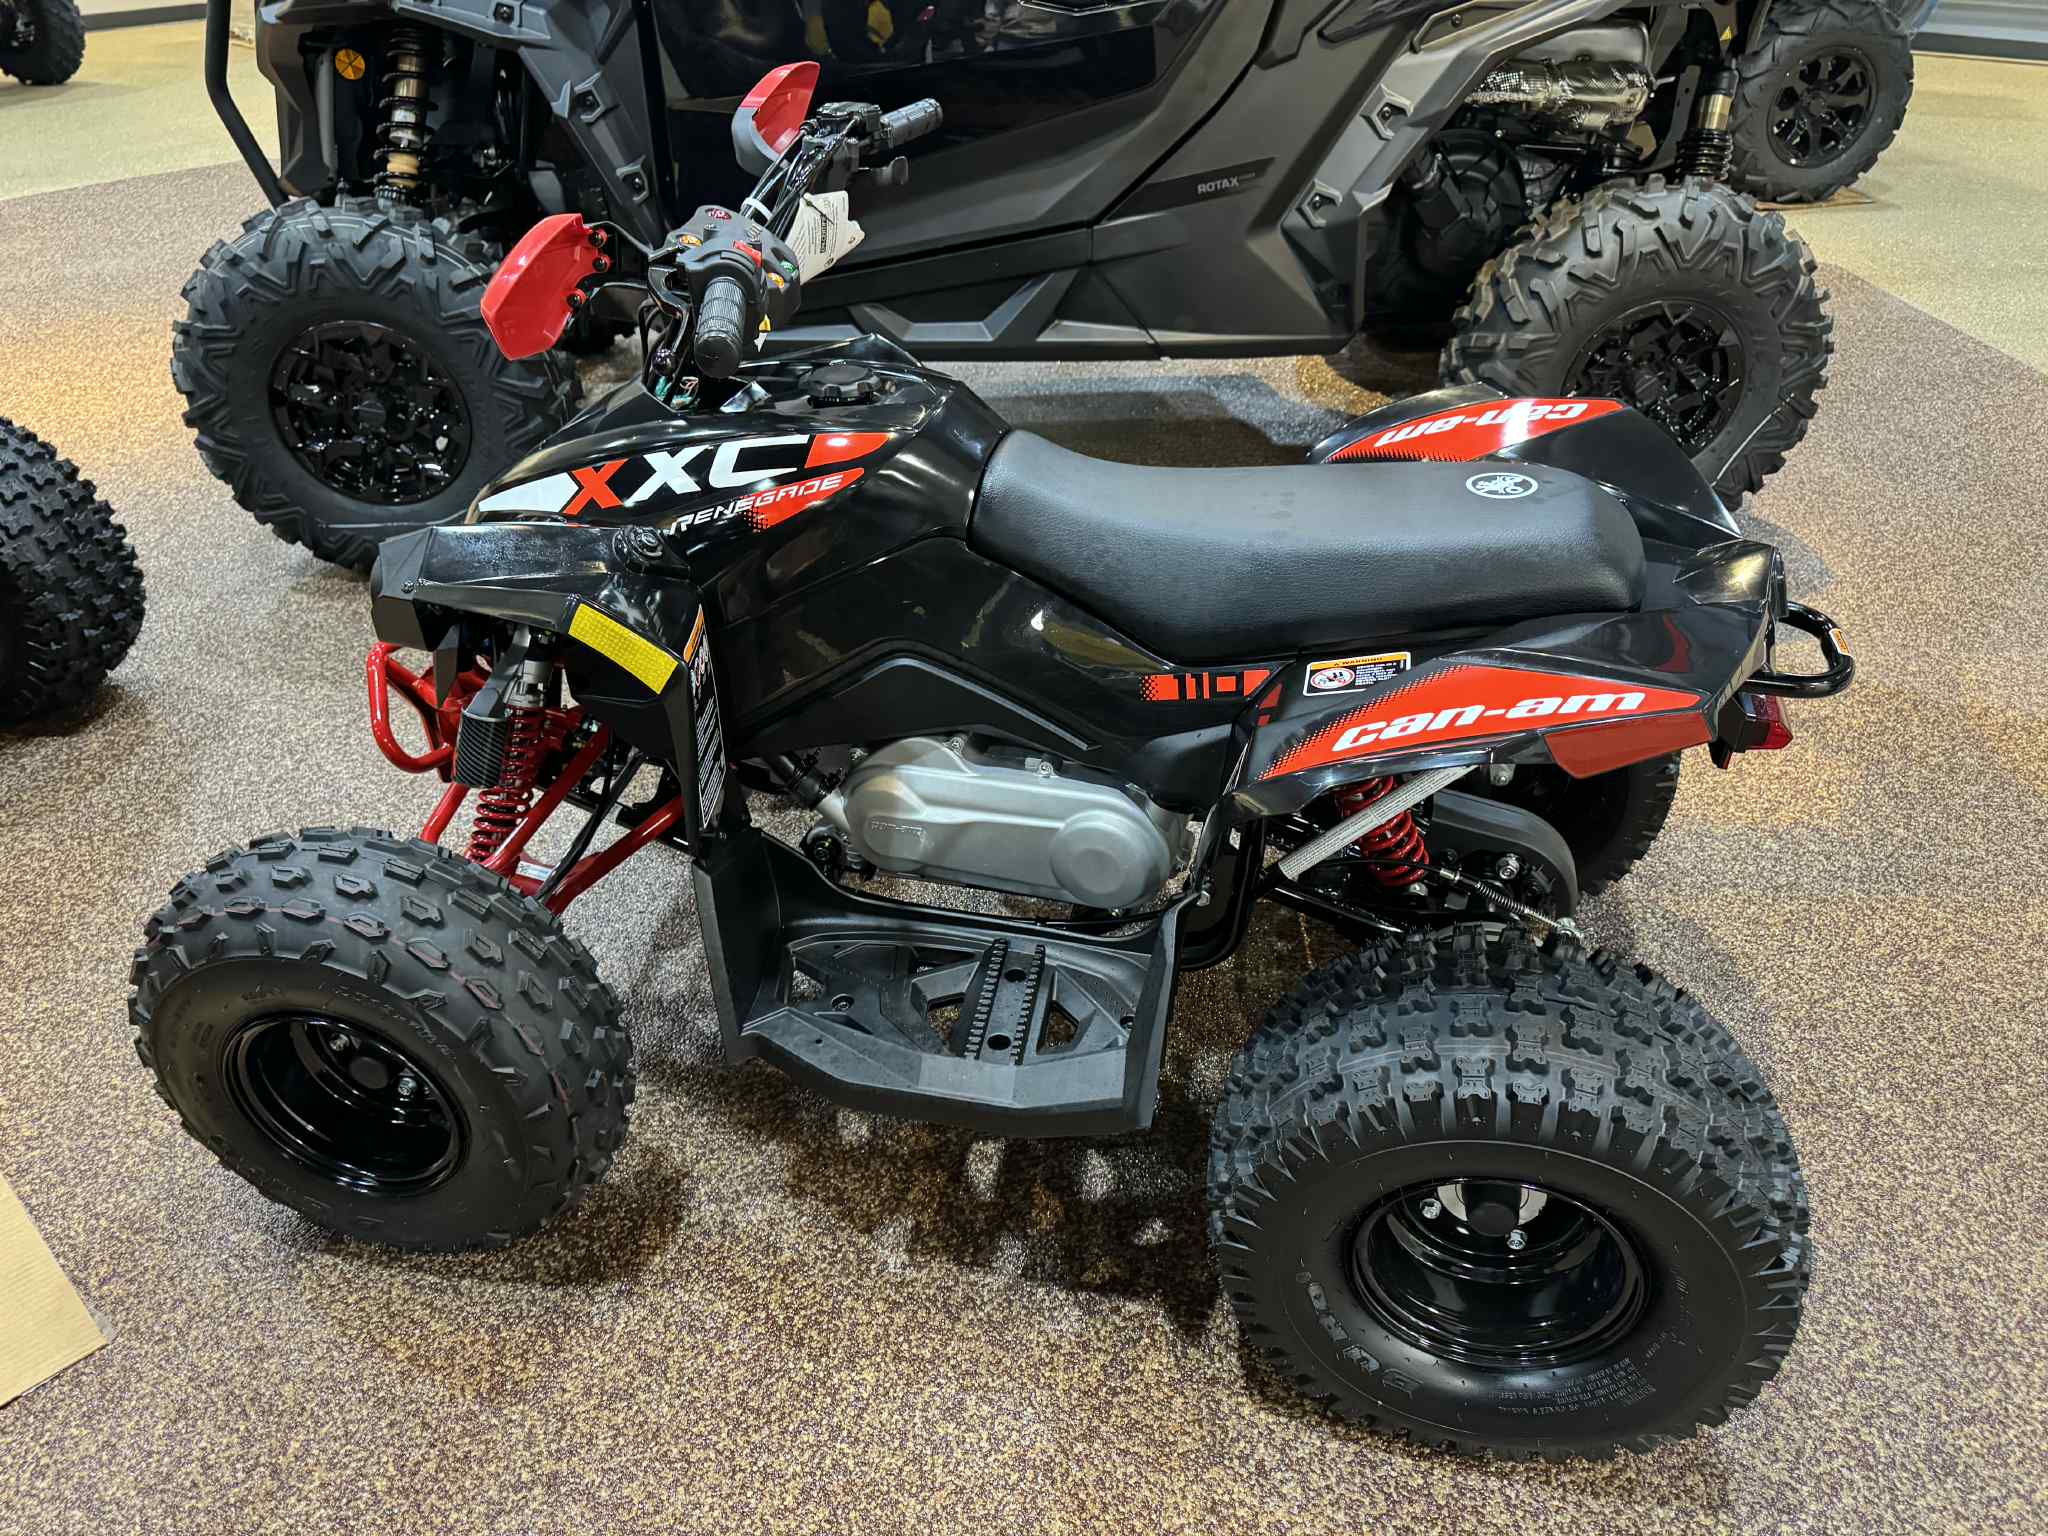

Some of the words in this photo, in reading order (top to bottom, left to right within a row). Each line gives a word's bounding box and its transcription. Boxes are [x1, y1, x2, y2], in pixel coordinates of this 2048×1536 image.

[1197, 176, 1240, 195] ROTAX
[562, 434, 810, 515] XXC
[670, 474, 844, 536] RENEGADE
[1331, 692, 1647, 752] can-am
